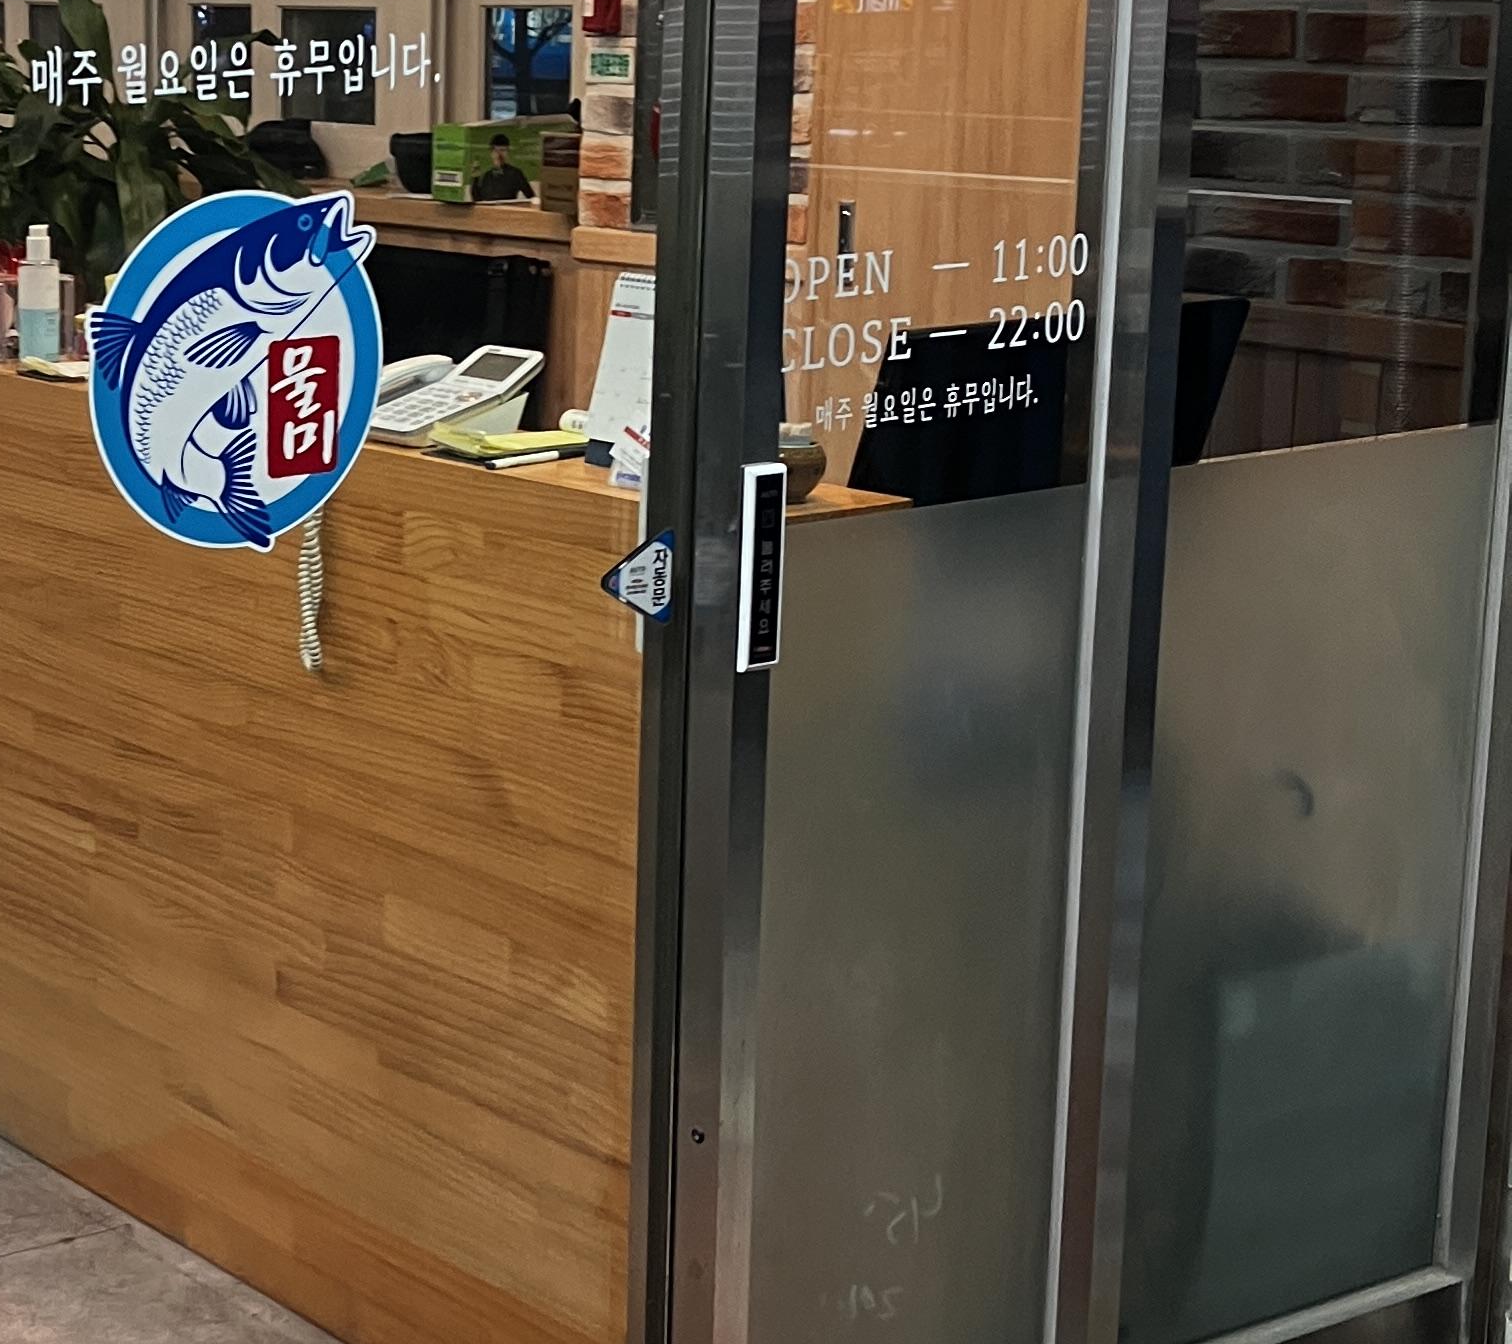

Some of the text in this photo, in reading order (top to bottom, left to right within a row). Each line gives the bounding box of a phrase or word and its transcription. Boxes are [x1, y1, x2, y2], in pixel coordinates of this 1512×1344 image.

[31, 32, 441, 108] 매주 월요일은 휴무입니다.
[992, 232, 1089, 284] 11:00
[988, 298, 1086, 351] 22:00
[270, 345, 336, 464] 물미
[815, 373, 1039, 433] 매주 월요일은 휴무입니다.
[651, 547, 668, 607] 자동문
